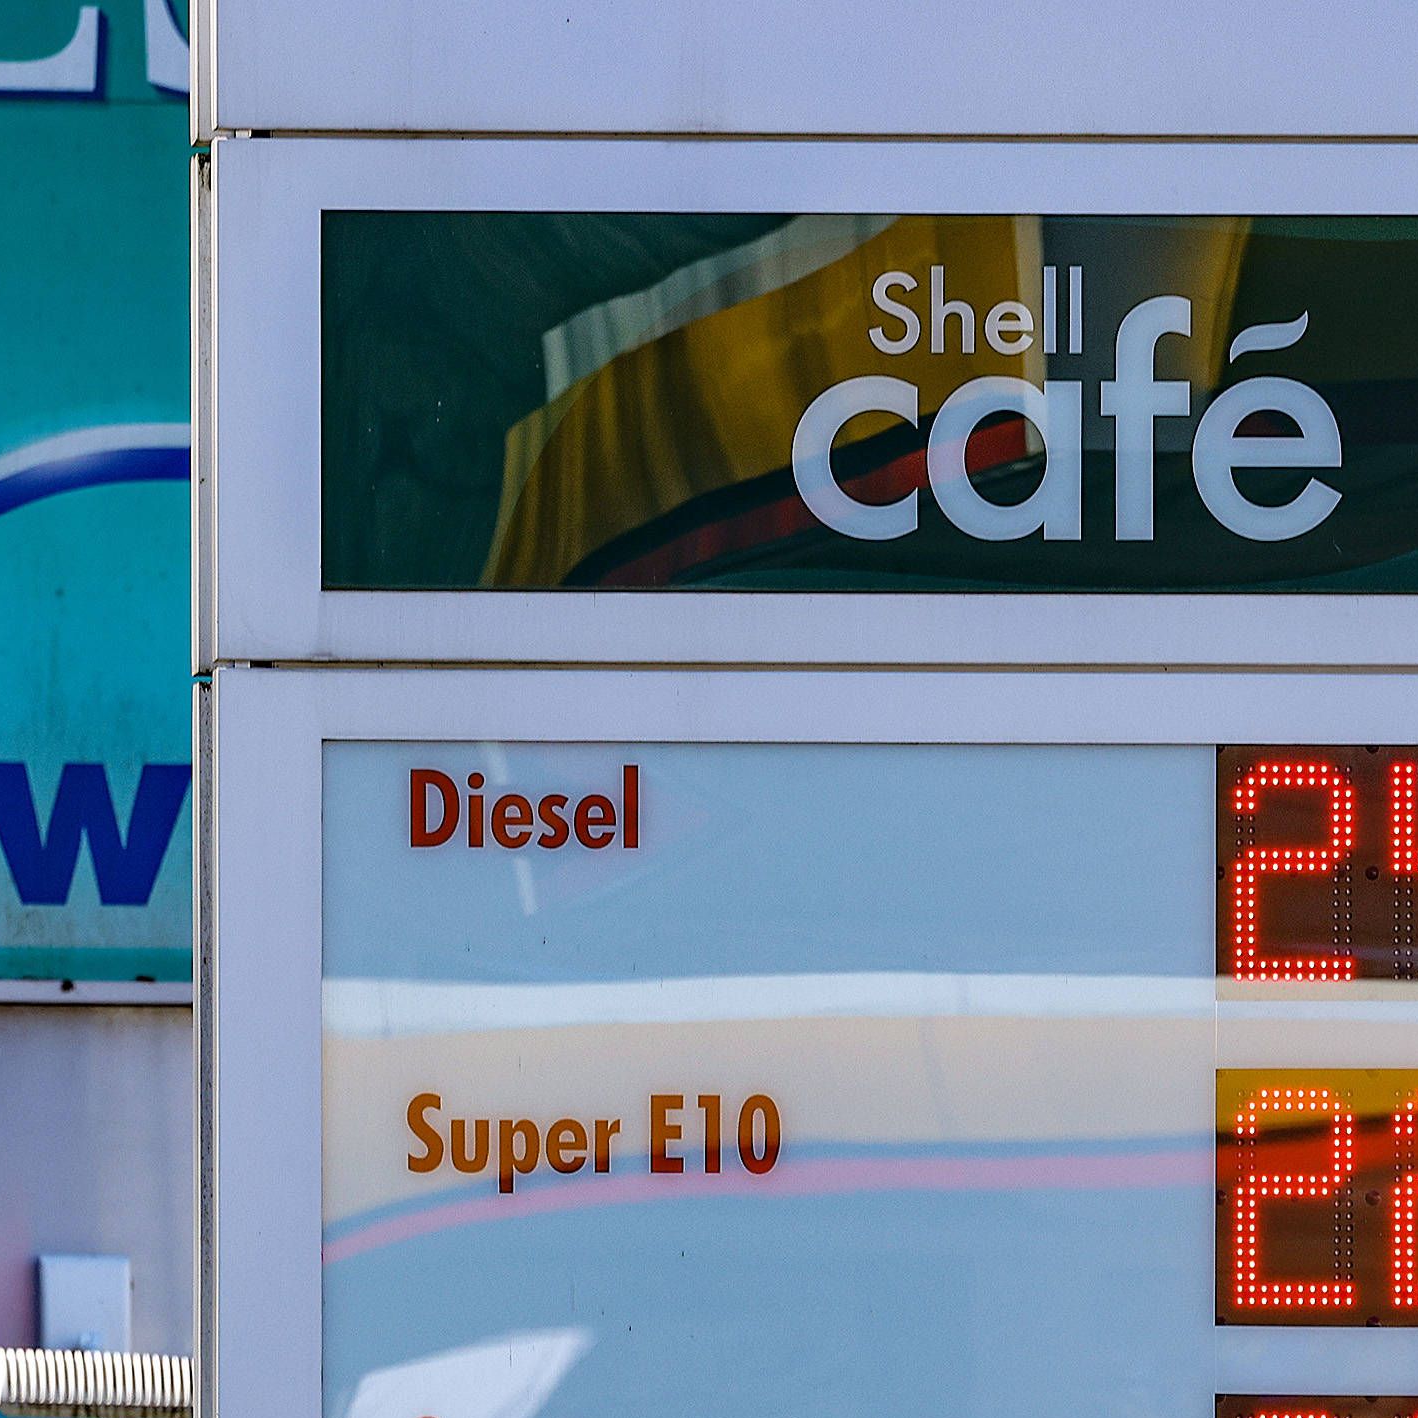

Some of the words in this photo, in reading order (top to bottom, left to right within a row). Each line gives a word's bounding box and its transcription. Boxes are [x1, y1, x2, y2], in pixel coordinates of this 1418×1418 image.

[868, 265, 1083, 355] Shell
[792, 295, 1343, 542] café
[409, 764, 640, 849] Diesel
[406, 1093, 621, 1194] Super
[650, 1093, 781, 1175] E10
